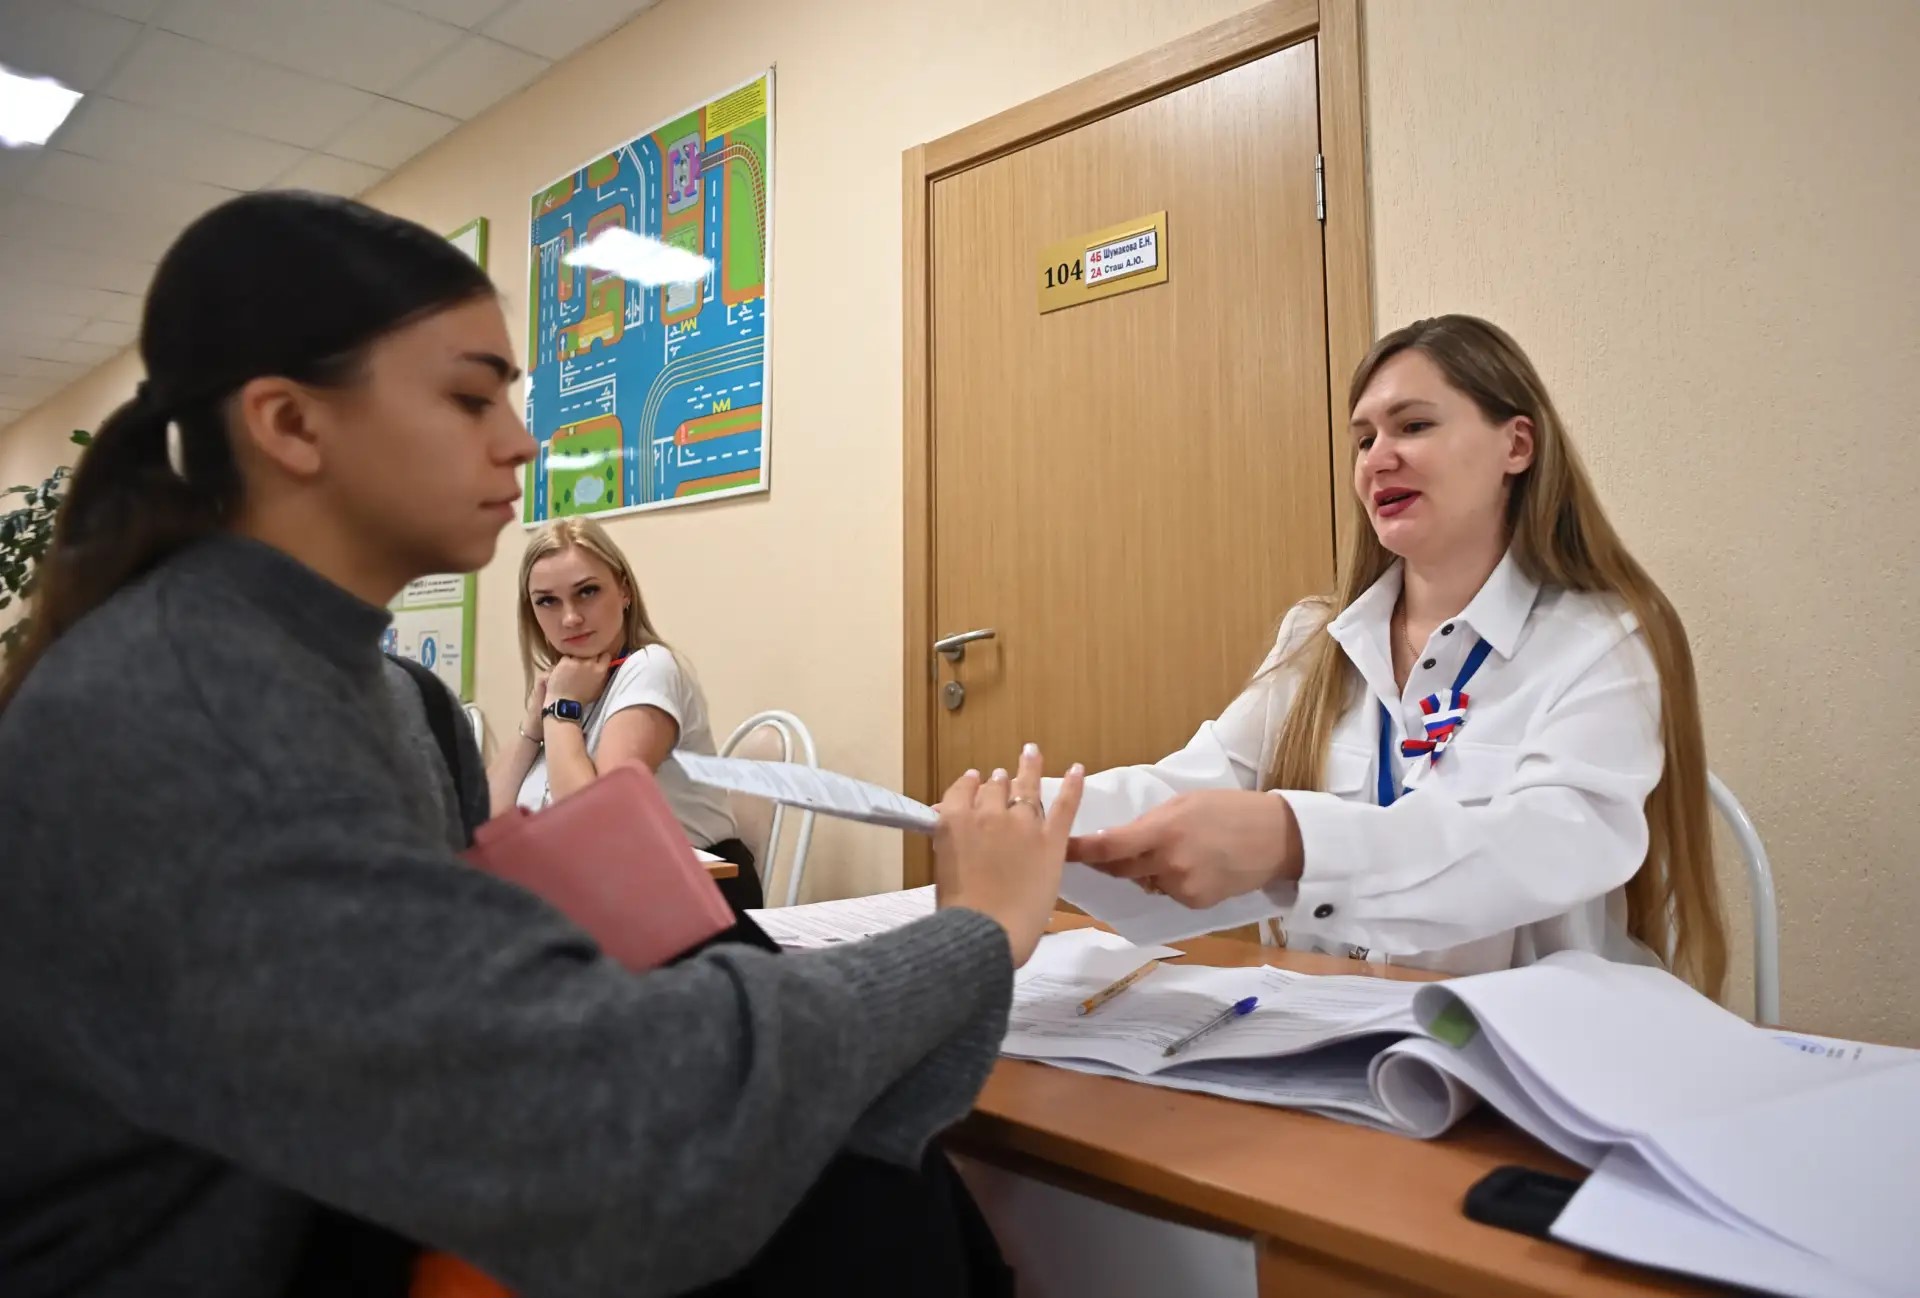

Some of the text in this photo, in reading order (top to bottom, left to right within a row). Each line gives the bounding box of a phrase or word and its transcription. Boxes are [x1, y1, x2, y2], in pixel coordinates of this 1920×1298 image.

[1090, 235, 1152, 263] 4Б Шумакова Е.Н.
[1045, 259, 1083, 288] 104
[1091, 256, 1144, 279] 2А Сташ А.Ю.
